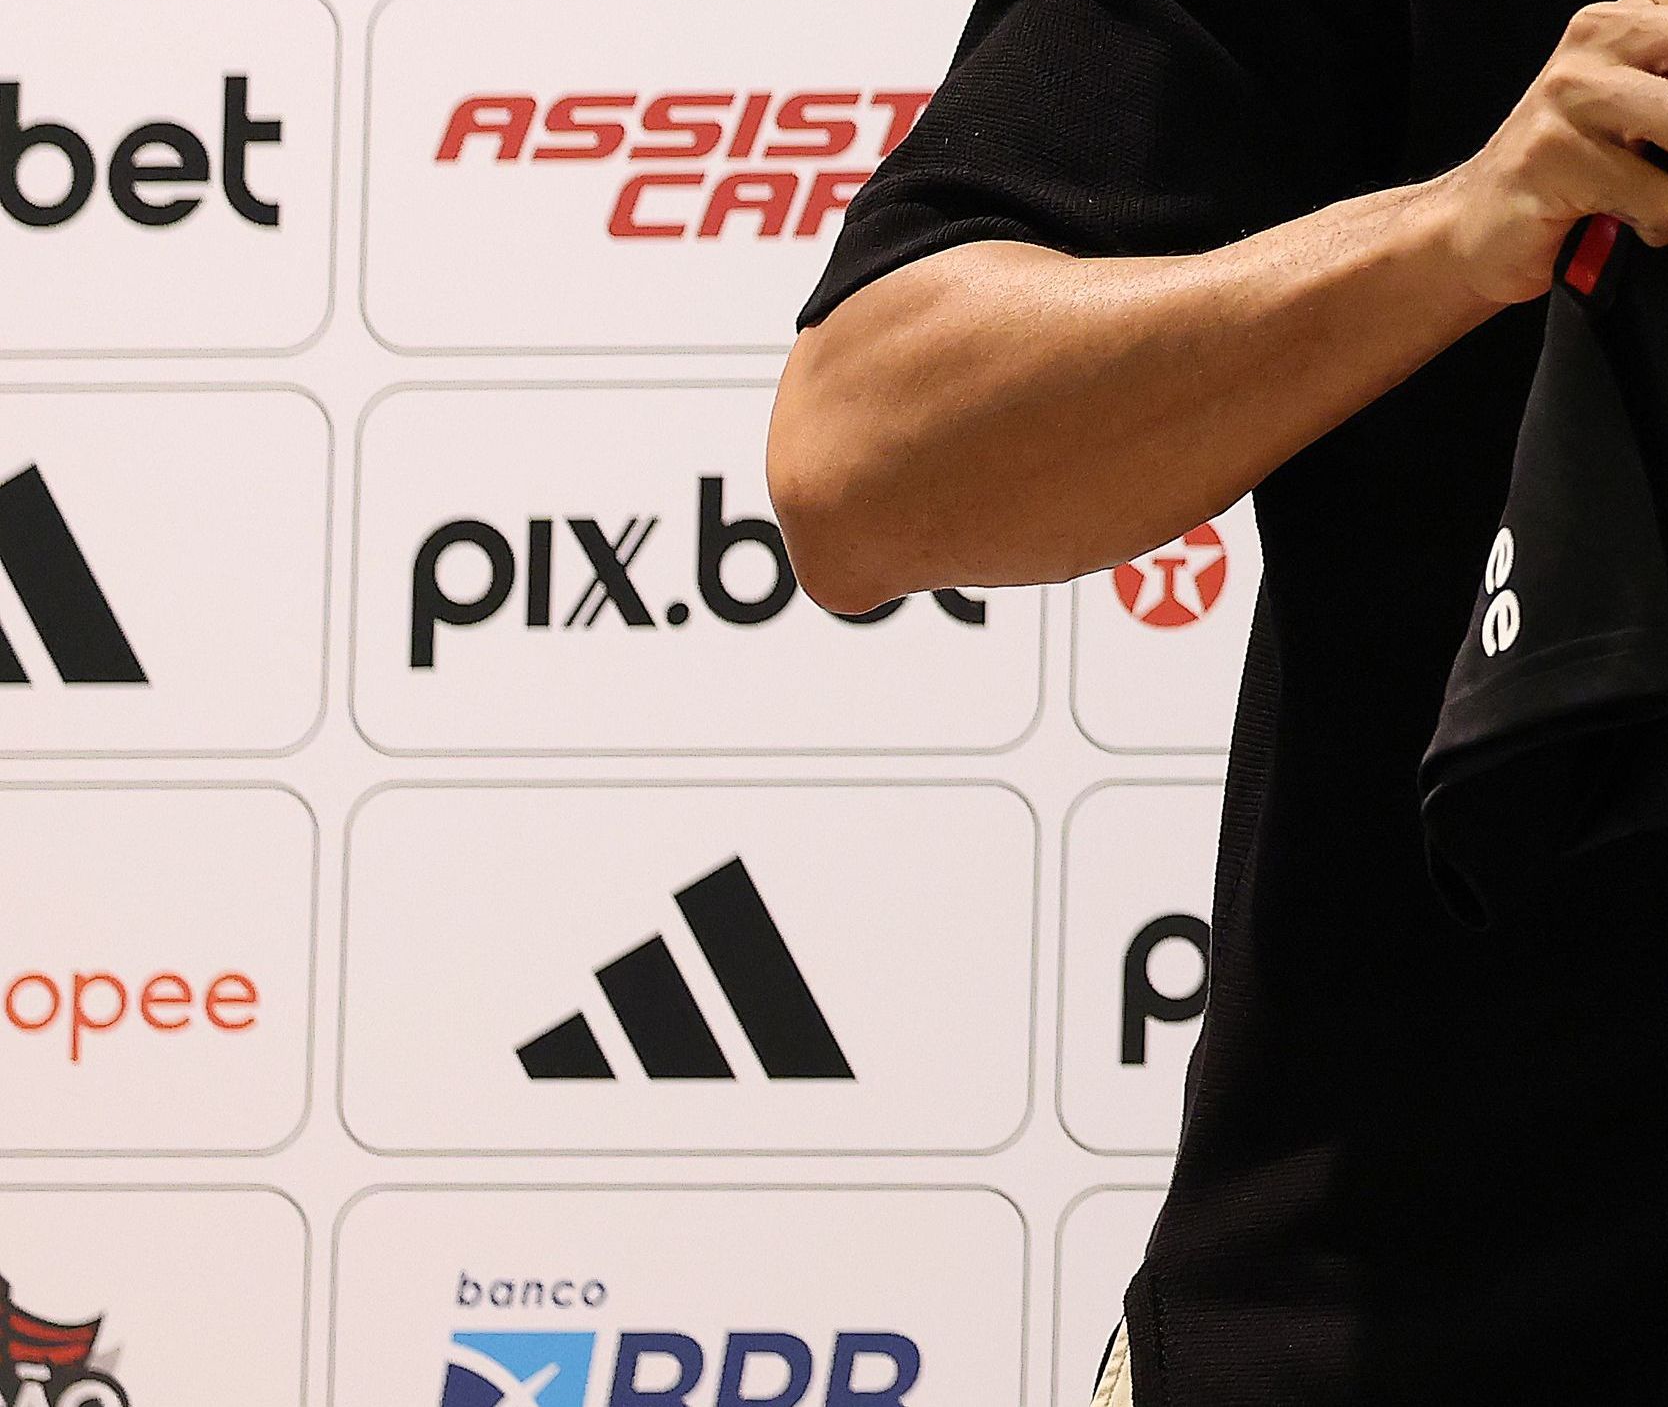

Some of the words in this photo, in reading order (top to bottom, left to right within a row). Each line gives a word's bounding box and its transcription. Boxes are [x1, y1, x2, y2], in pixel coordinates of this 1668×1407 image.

[608, 171, 874, 237] CAR
[410, 476, 986, 668] pix.b
[5, 973, 258, 1062] opee
[458, 1273, 606, 1306] banco
